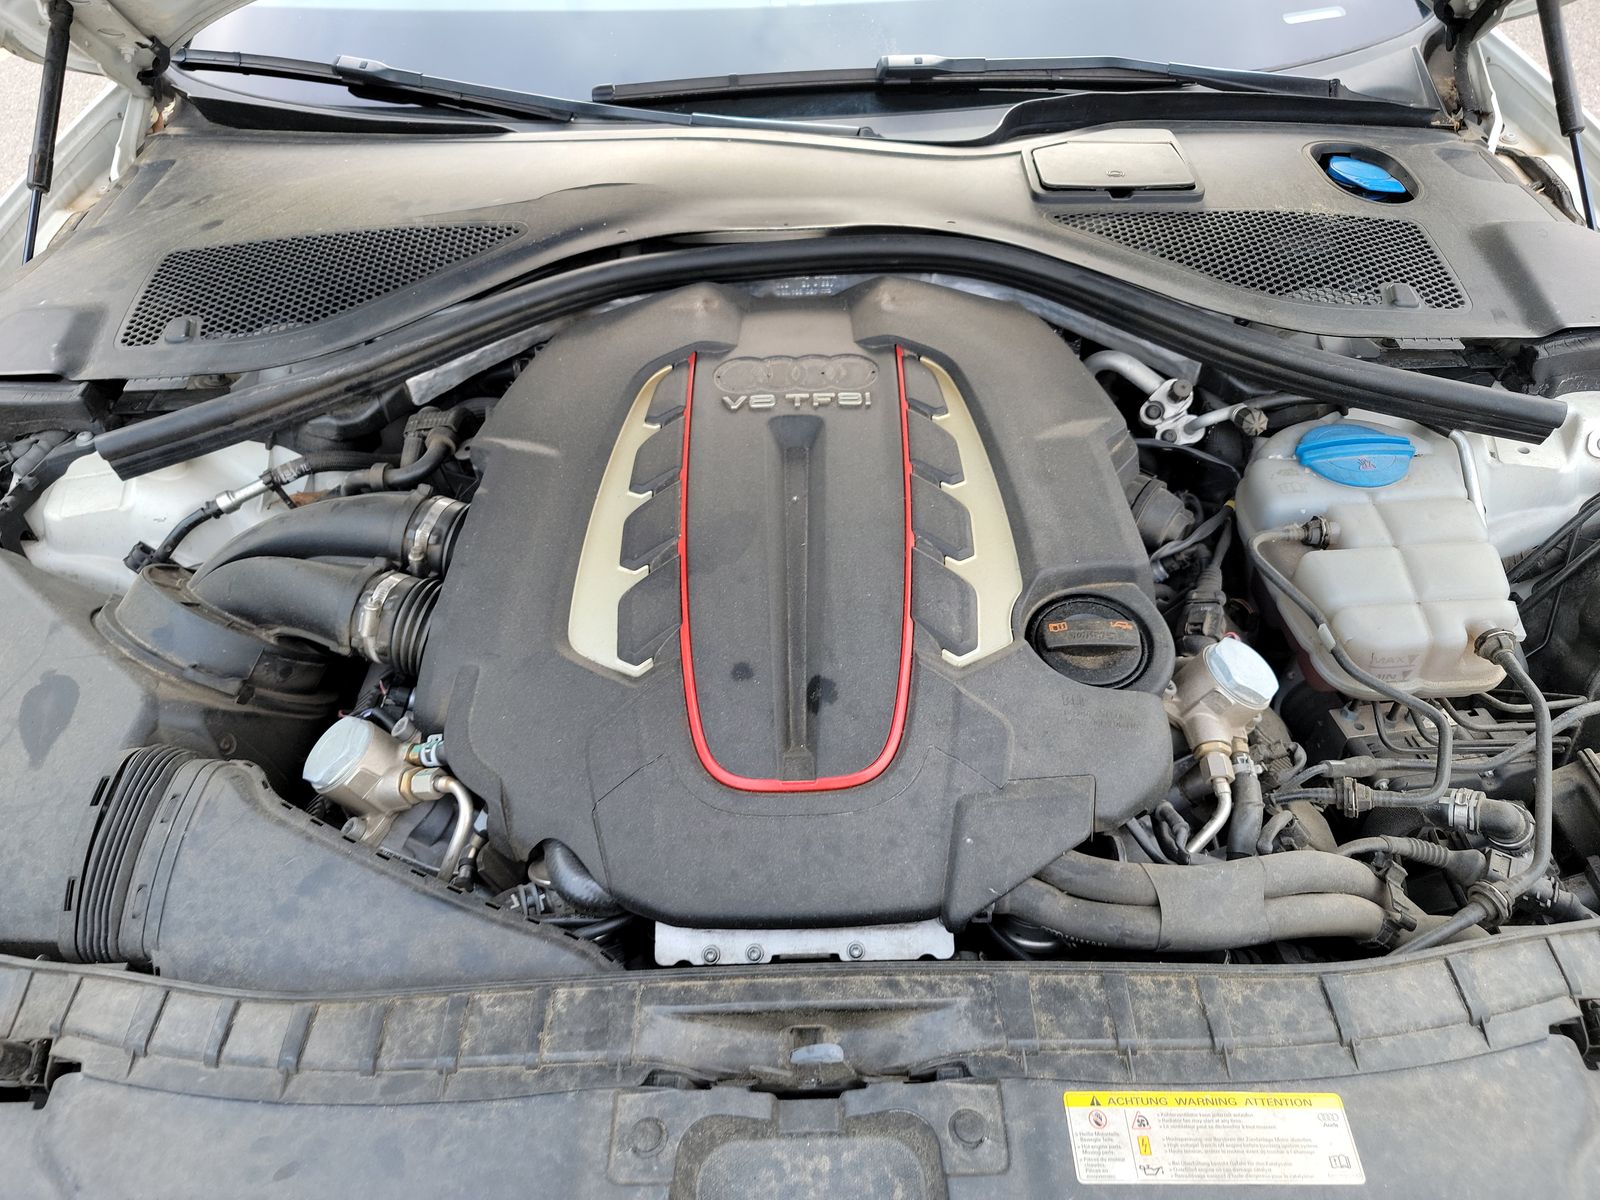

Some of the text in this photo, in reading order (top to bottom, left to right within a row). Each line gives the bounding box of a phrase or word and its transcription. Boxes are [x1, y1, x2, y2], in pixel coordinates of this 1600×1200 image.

[785, 391, 871, 408] TFSI
[1107, 1096, 1312, 1107] ACHTUNG WARNING ATTENTION
